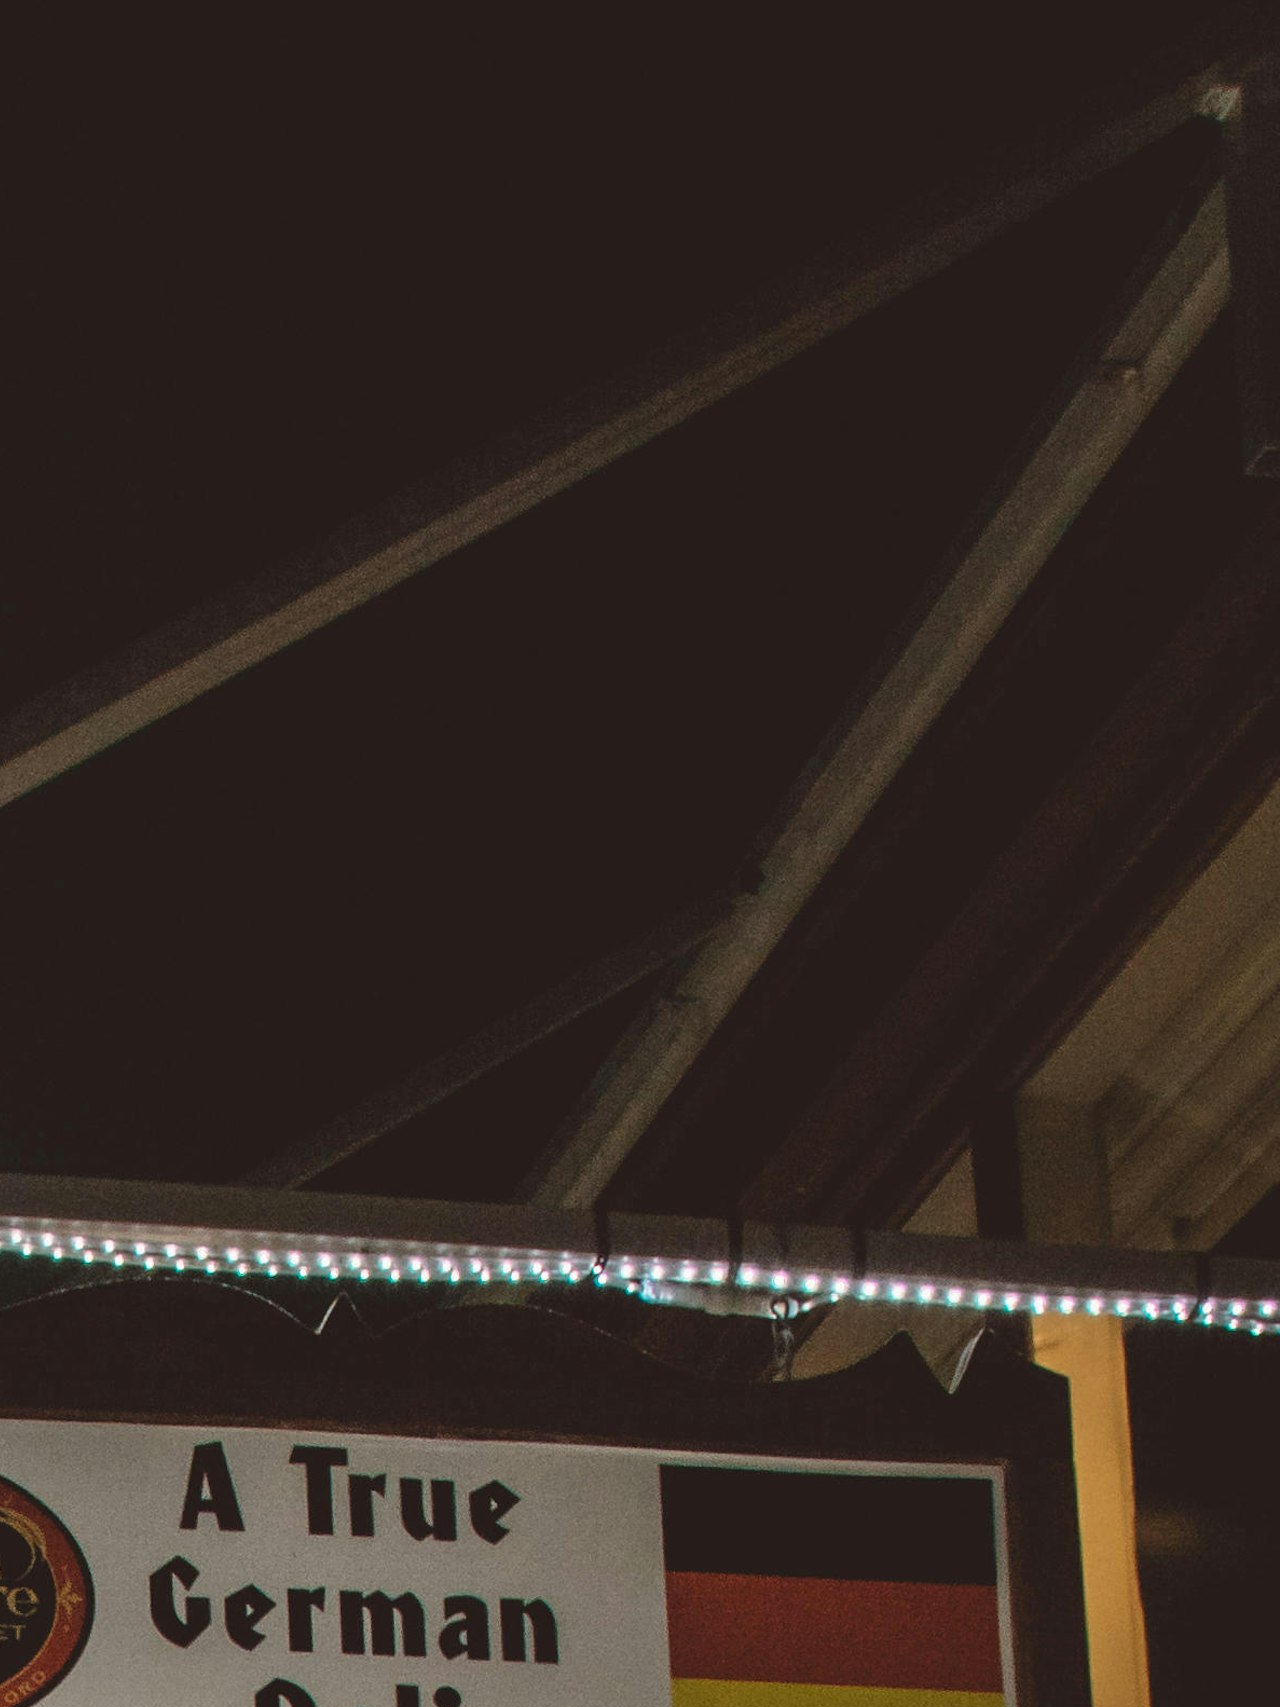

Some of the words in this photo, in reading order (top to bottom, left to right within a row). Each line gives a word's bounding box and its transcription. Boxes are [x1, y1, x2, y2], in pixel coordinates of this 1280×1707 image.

[179, 1440, 245, 1532] A
[288, 1445, 522, 1545] True
[148, 1555, 560, 1665] German
